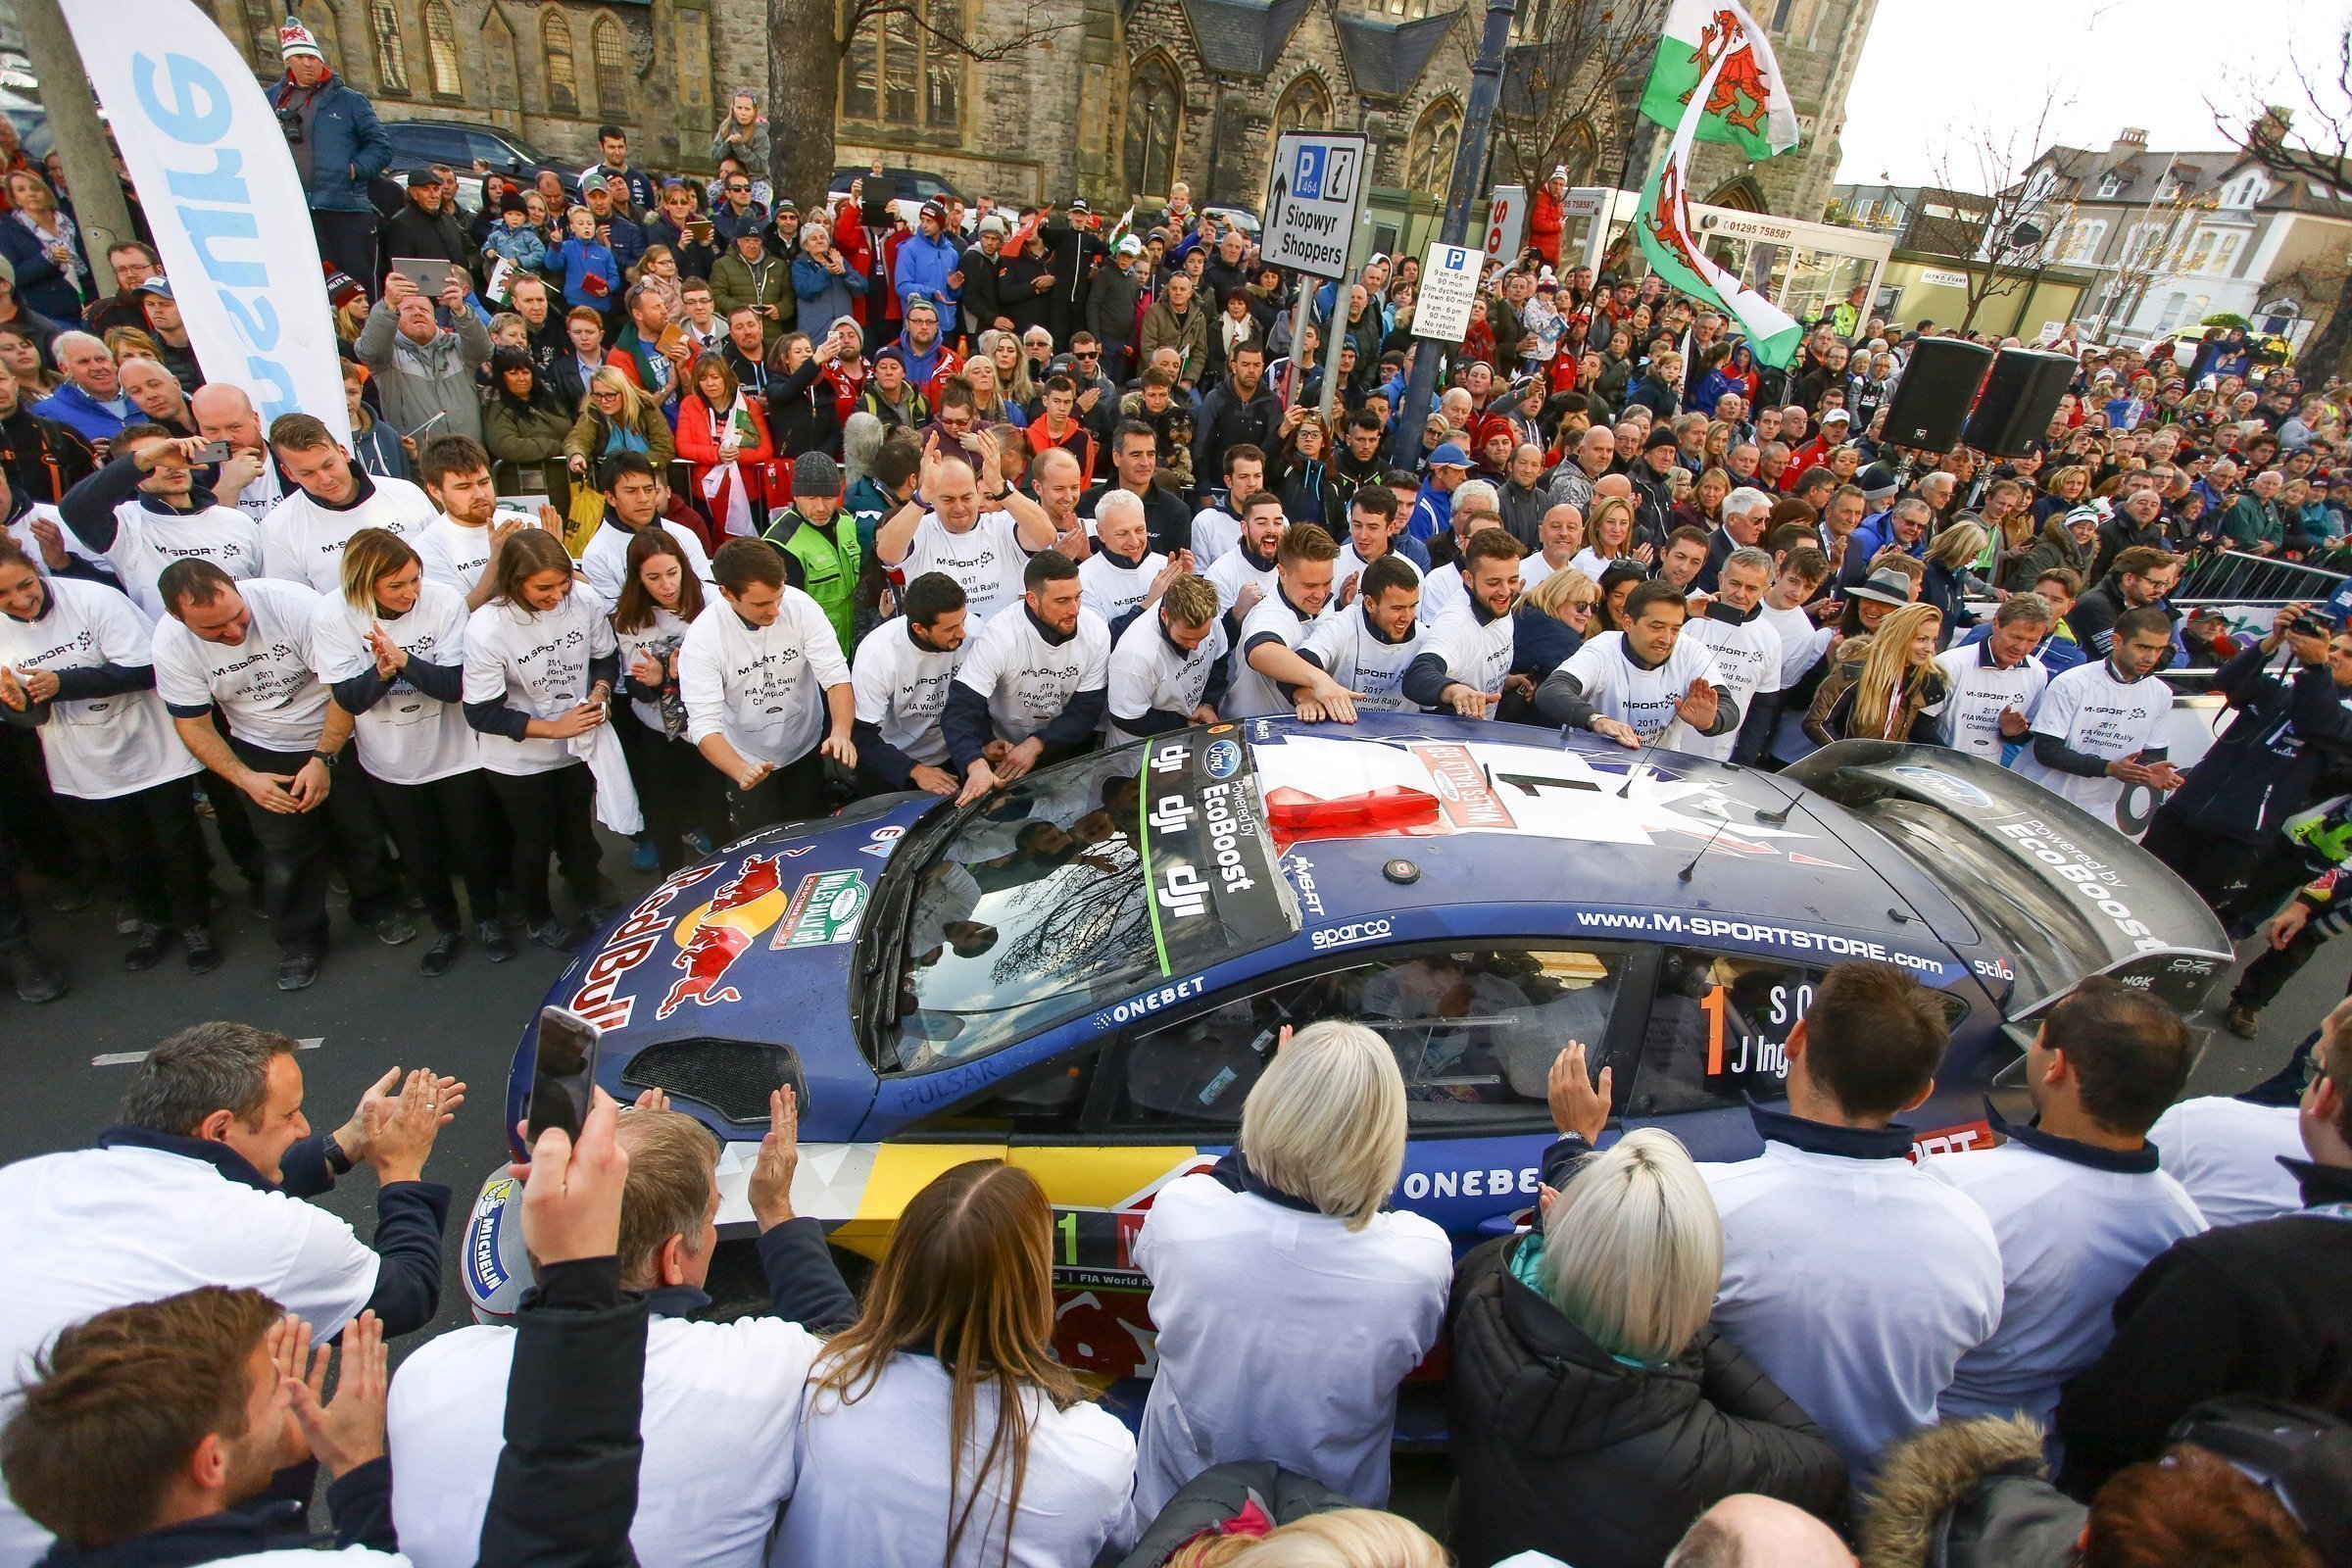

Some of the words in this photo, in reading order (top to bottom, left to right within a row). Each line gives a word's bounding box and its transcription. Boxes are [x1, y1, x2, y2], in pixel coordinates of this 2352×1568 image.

[1296, 151, 1315, 192] P
[1301, 180, 1318, 194] 464
[1285, 204, 1338, 236] Siopwyr
[1729, 221, 1757, 234] 01295
[1759, 226, 1791, 239] 758587
[1281, 232, 1342, 265] Shoppers
[1448, 250, 1463, 268] P
[1423, 283, 1437, 292] Dim
[1438, 286, 1474, 299] dychwelyd
[1427, 293, 1445, 302] fewn
[1446, 295, 1456, 304] 60
[1414, 325, 1435, 334] within
[1446, 331, 1463, 340] mins
[1435, 321, 1456, 331] return
[979, 581, 1000, 593] Rally
[255, 670, 275, 682] 2017
[1718, 662, 1739, 671] 2017
[1735, 674, 1752, 685] Rally
[926, 690, 946, 702] 2017
[1362, 685, 1385, 696] 2017
[1380, 696, 1402, 708] Rally
[1637, 718, 1660, 727] 2017
[2113, 732, 2134, 743] Rally
[1205, 741, 1239, 775] Ford
[1426, 746, 1463, 759] GB
[1443, 760, 1480, 789] RALLY
[1231, 779, 1254, 824] Powered
[1462, 788, 1505, 824] WALES
[1203, 782, 1256, 894] EcoBoost
[1241, 822, 1255, 838] by
[2024, 819, 2103, 872] Powered
[2100, 864, 2129, 889] by
[811, 872, 856, 904] WALES
[1995, 824, 2170, 952] EcoBoost
[604, 860, 727, 949] Red
[798, 902, 832, 929] RALLY
[791, 929, 826, 944] GB
[1311, 918, 1391, 951] sparco
[1577, 911, 1943, 975] www.M-SPORTSTORE.com
[1974, 958, 2015, 981] Stilo
[2122, 975, 2155, 989] NGK
[569, 934, 662, 1033] Bull
[1112, 976, 1205, 1023] ONEBET
[1770, 985, 1788, 1025] S
[1700, 985, 1725, 1075] 1
[1731, 1036, 1748, 1073] J
[899, 1058, 997, 1111] PULSAR
[1057, 1212, 1078, 1266] 1
[477, 1217, 504, 1291] MICHELIN
[1079, 1274, 1100, 1284] FIA
[1102, 1275, 1139, 1287] World
